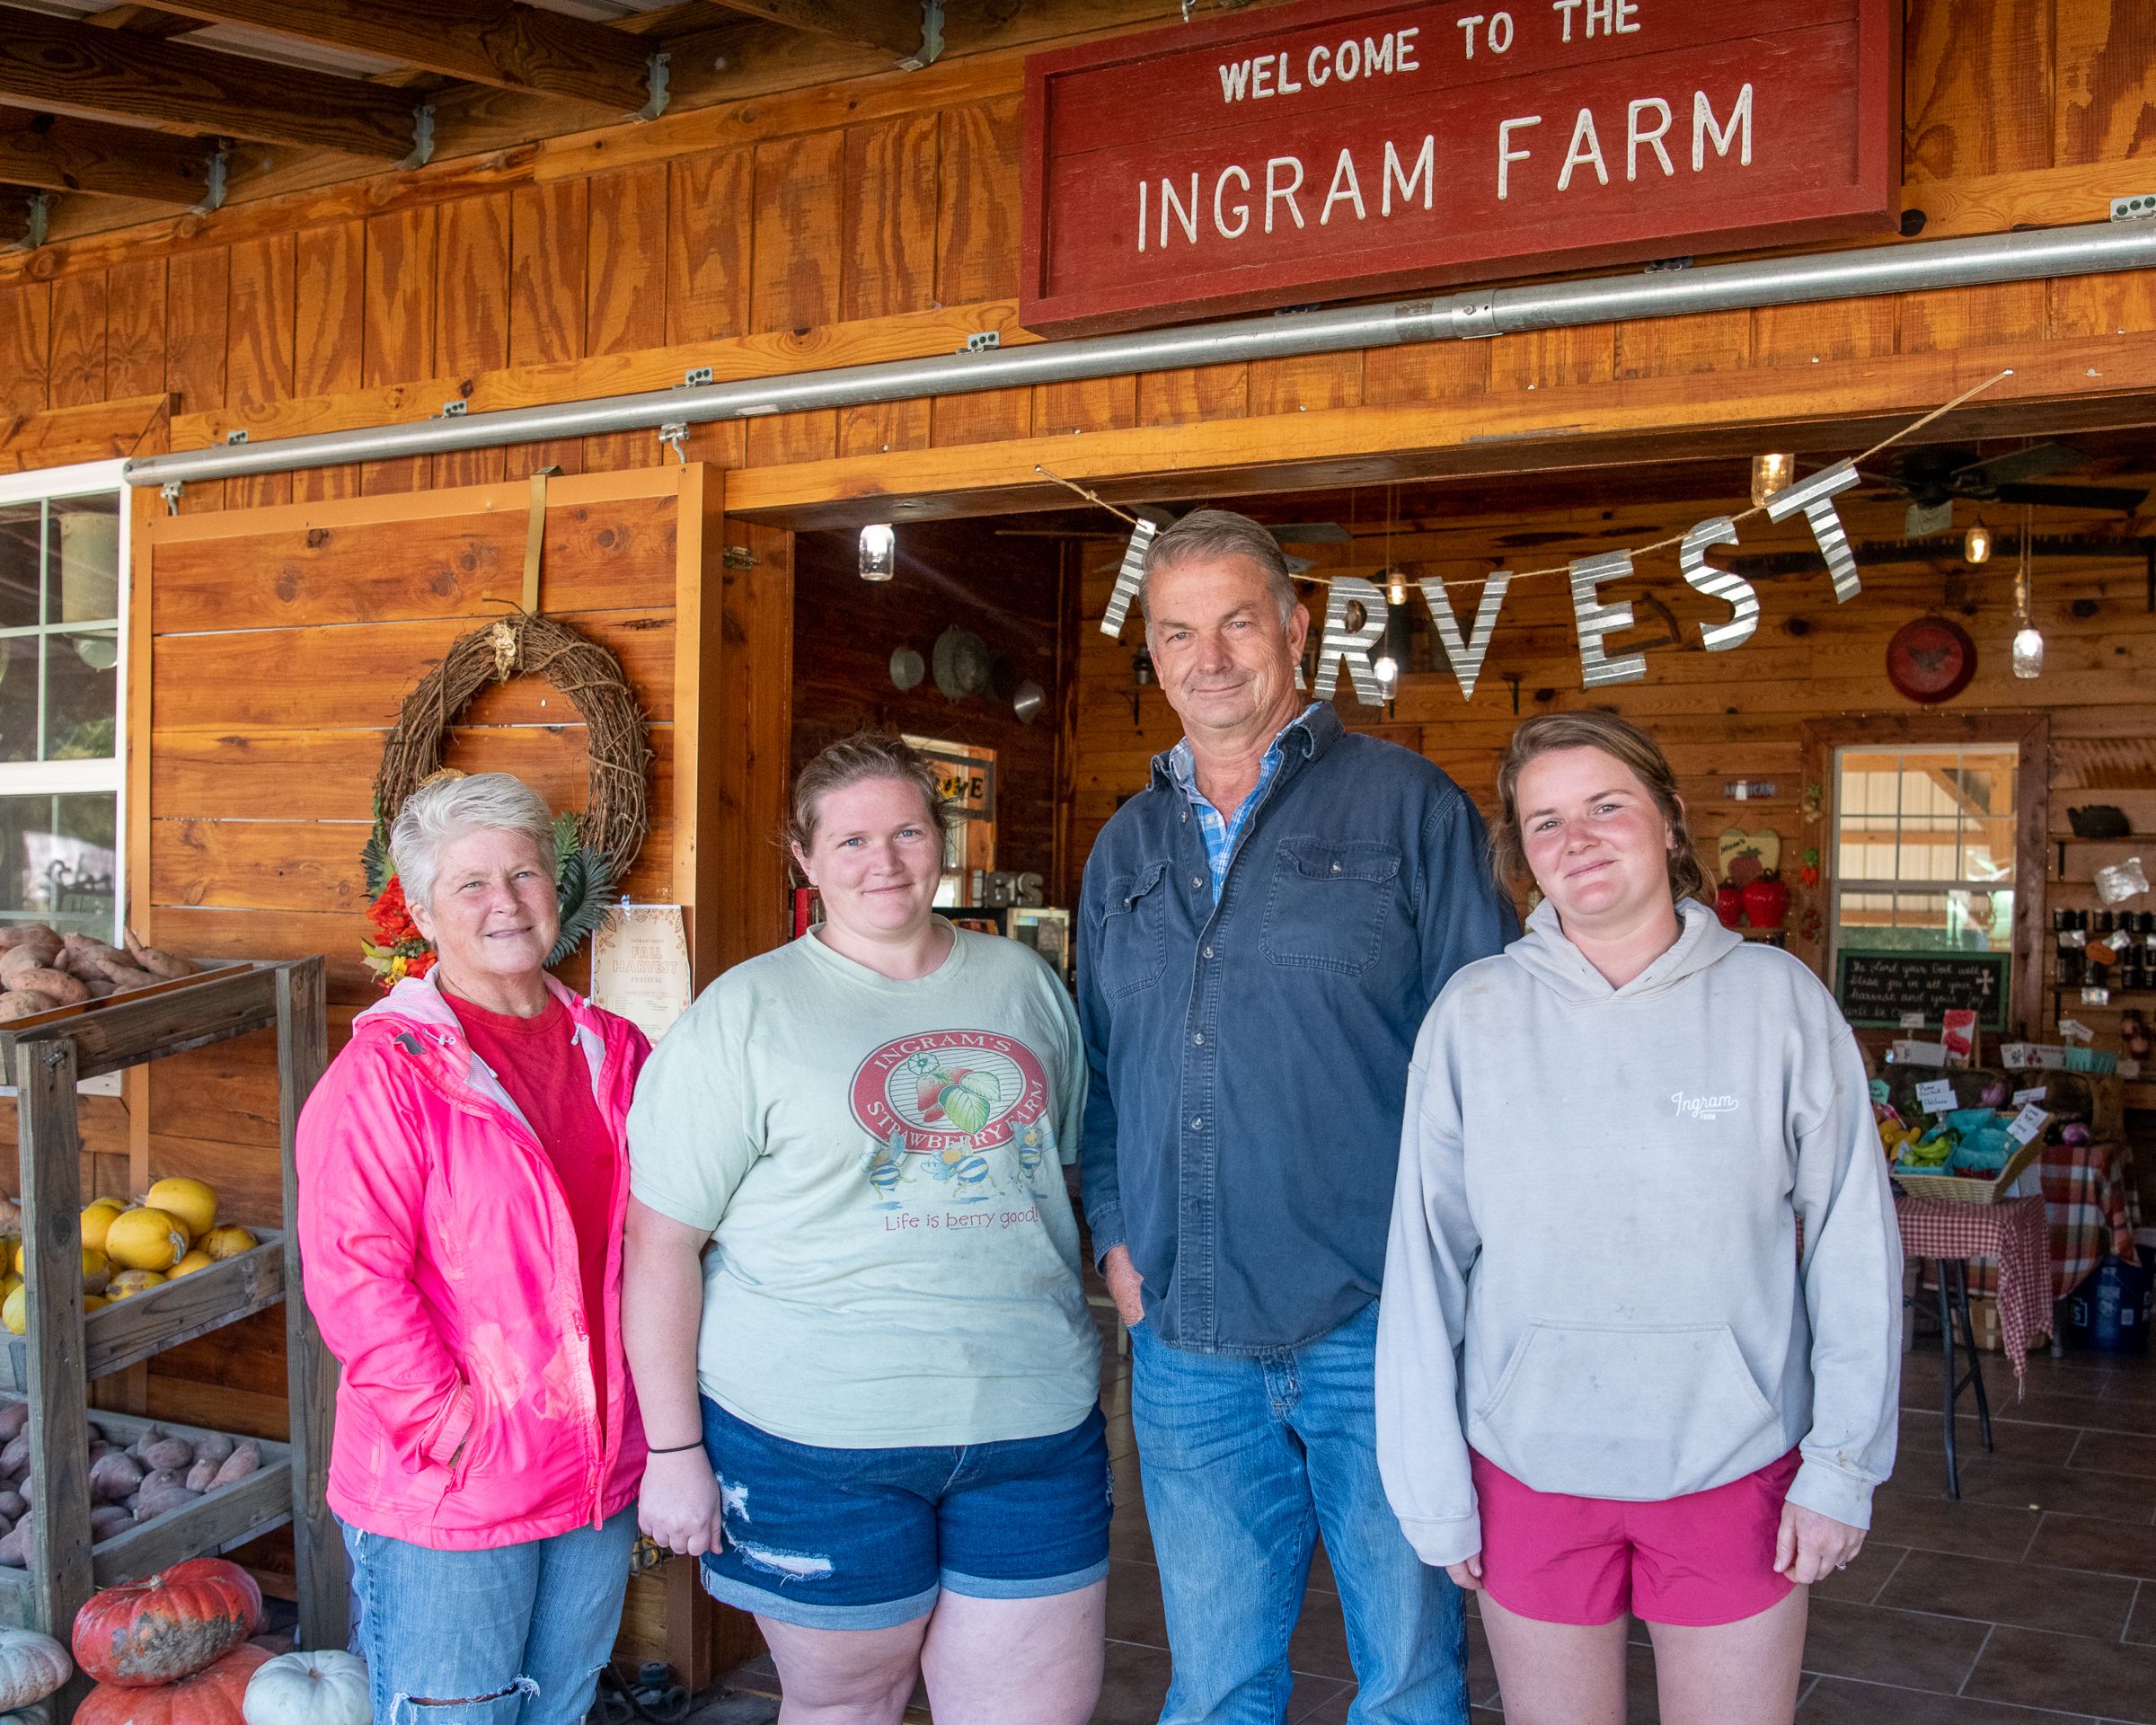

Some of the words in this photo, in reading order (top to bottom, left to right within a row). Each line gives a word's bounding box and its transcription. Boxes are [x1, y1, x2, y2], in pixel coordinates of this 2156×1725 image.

[1218, 27, 1420, 103] WELCOME
[1456, 12, 1513, 60] TO
[1552, 0, 1641, 43] THE
[1137, 134, 1436, 252] INGRAM
[1497, 83, 1753, 200] FARM
[1100, 456, 1861, 707] RVEST
[632, 946, 663, 960] FALL
[613, 960, 679, 974] HARVEST
[1902, 964, 1926, 978] your
[1926, 979, 1941, 989] all
[1900, 992, 1924, 1003] and
[873, 1033, 1012, 1070] INGRAM'S
[1005, 1079, 1043, 1132] FARM
[1671, 1091, 1739, 1119] Ingram
[885, 1213, 920, 1231] Life
[926, 1214, 940, 1228] is
[946, 1212, 995, 1230] berry
[1000, 1207, 1038, 1229] good!
